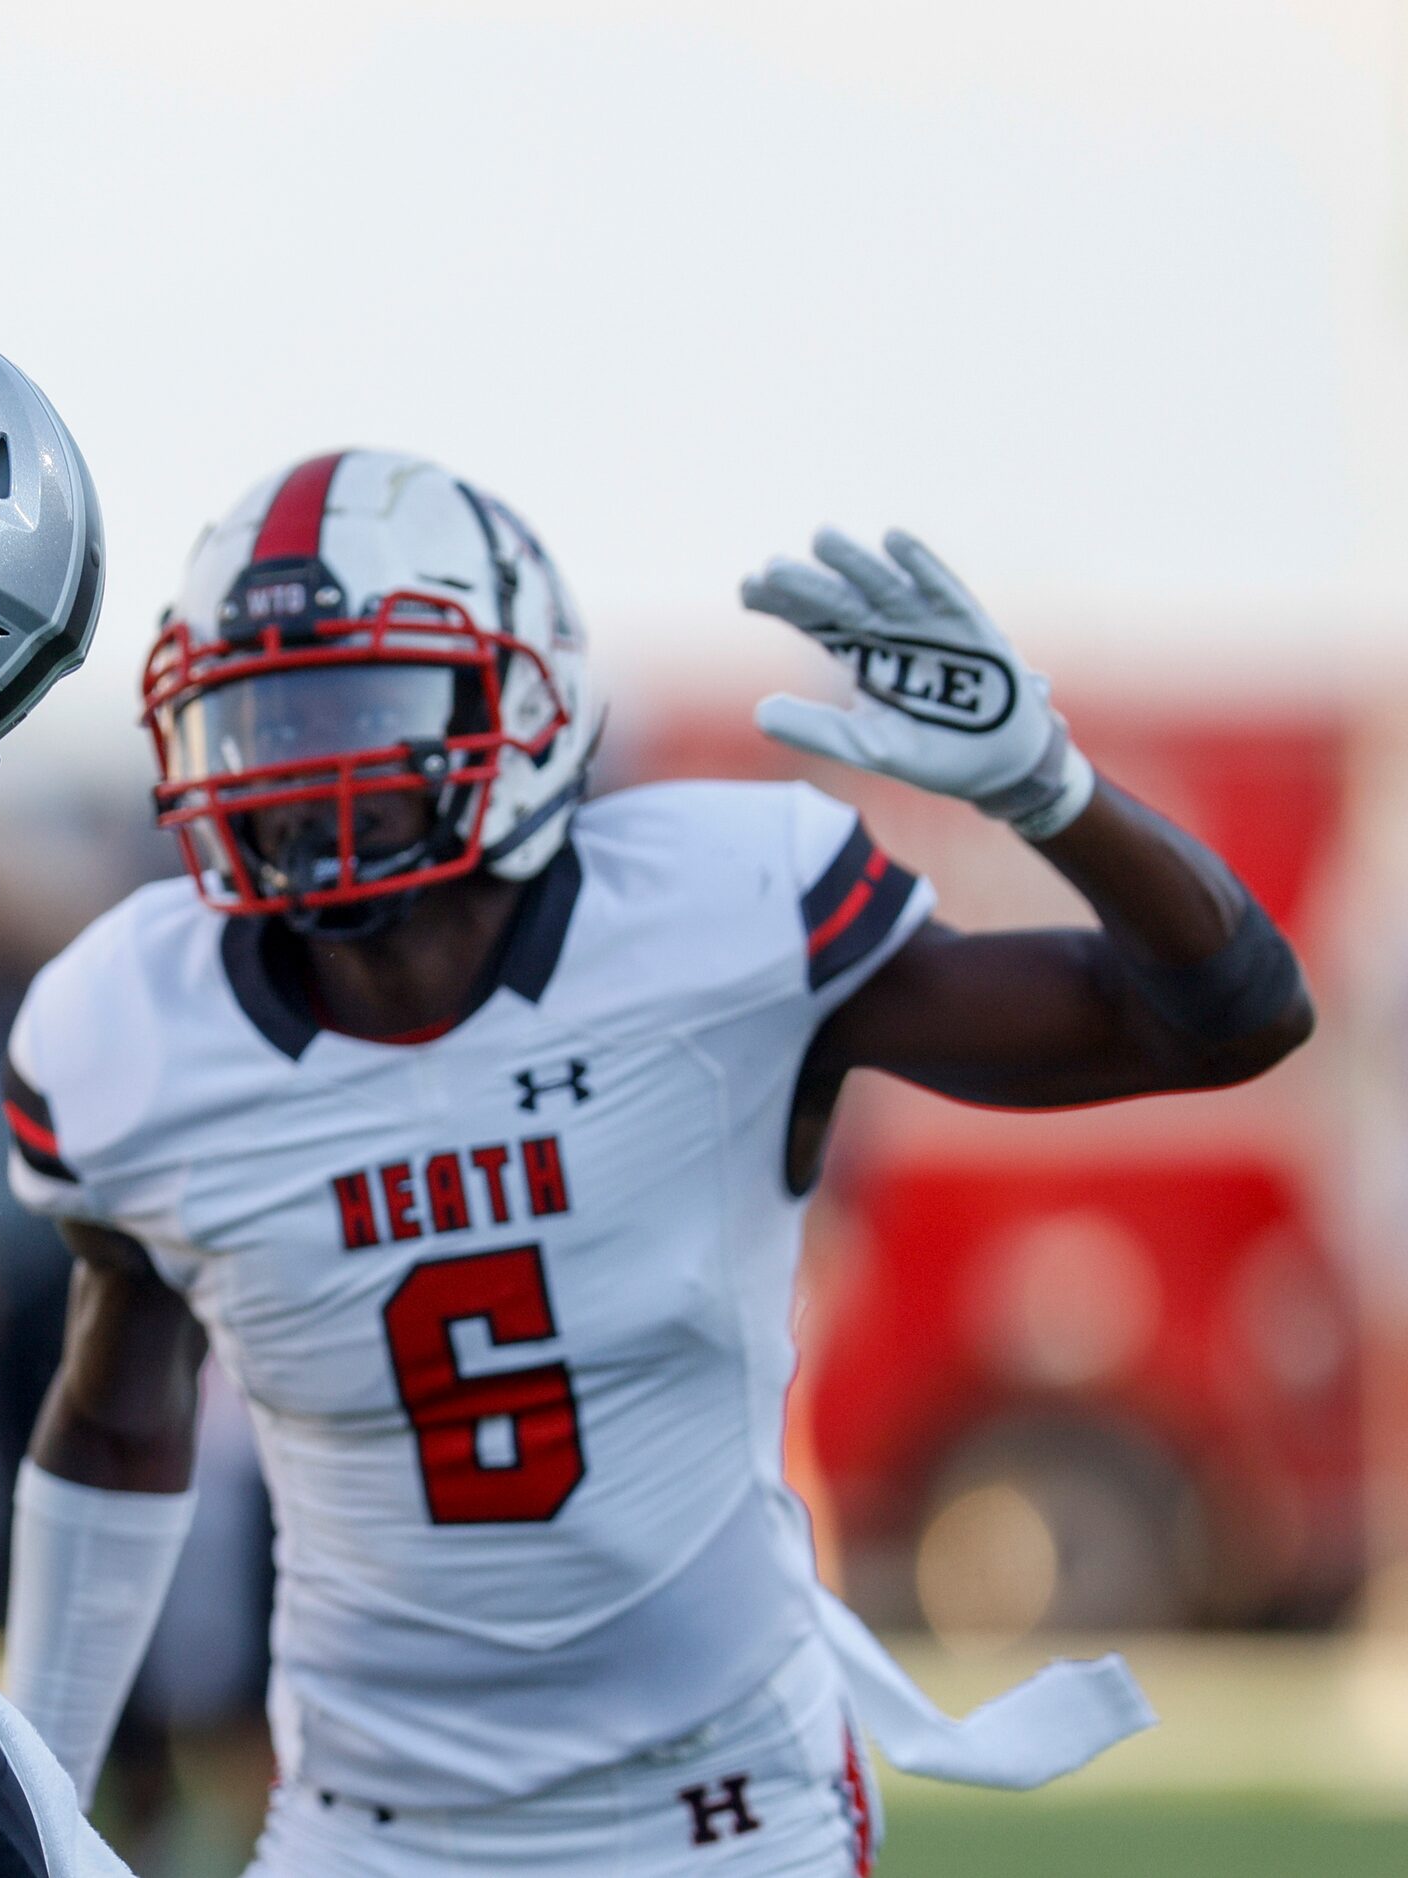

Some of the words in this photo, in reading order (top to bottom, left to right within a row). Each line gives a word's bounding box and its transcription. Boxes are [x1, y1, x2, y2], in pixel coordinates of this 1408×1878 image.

[828, 641, 982, 714] TLE
[332, 1134, 570, 1249] HEATH
[382, 1243, 587, 1525] 6
[679, 1774, 760, 1845] H
